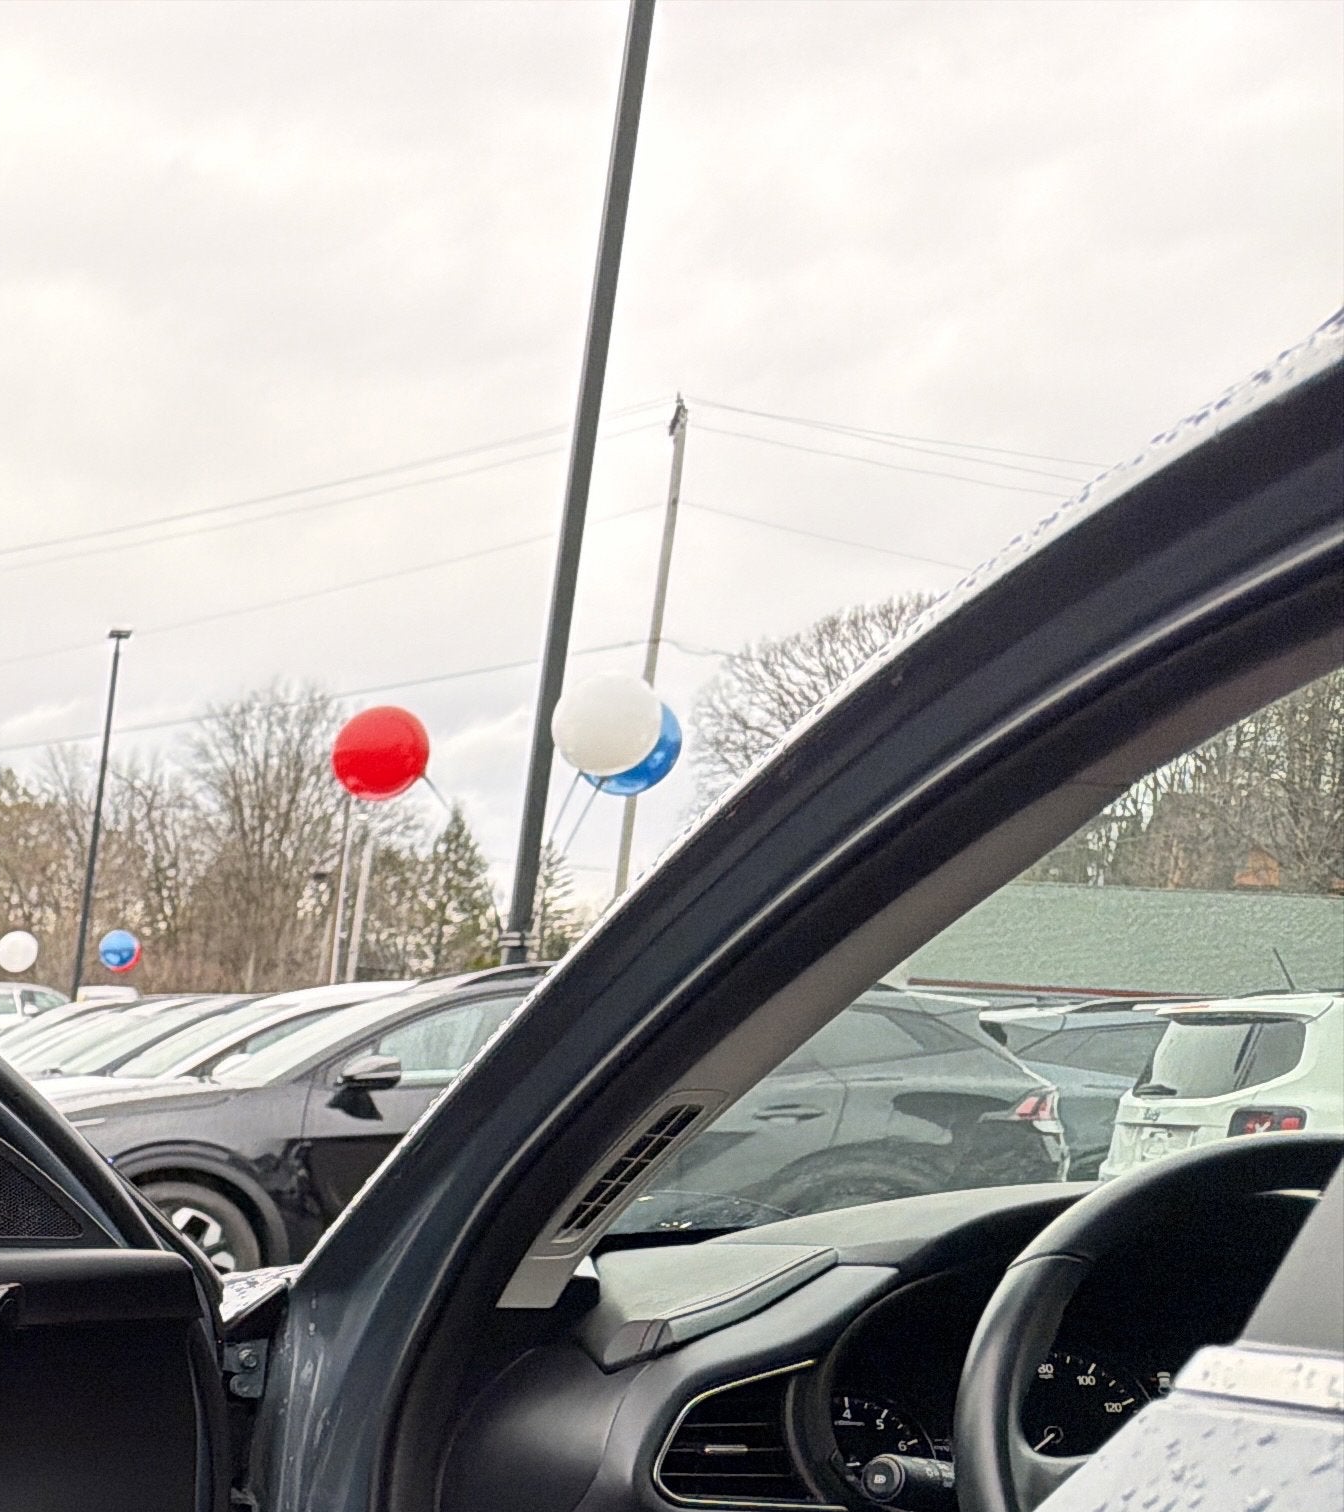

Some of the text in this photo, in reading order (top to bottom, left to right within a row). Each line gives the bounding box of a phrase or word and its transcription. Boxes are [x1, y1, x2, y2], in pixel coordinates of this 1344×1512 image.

[1076, 1375, 1096, 1386] 100
[1104, 1402, 1122, 1413] 120
[842, 1408, 852, 1420] 4
[875, 1419, 885, 1430] 5
[898, 1440, 908, 1452] 6
